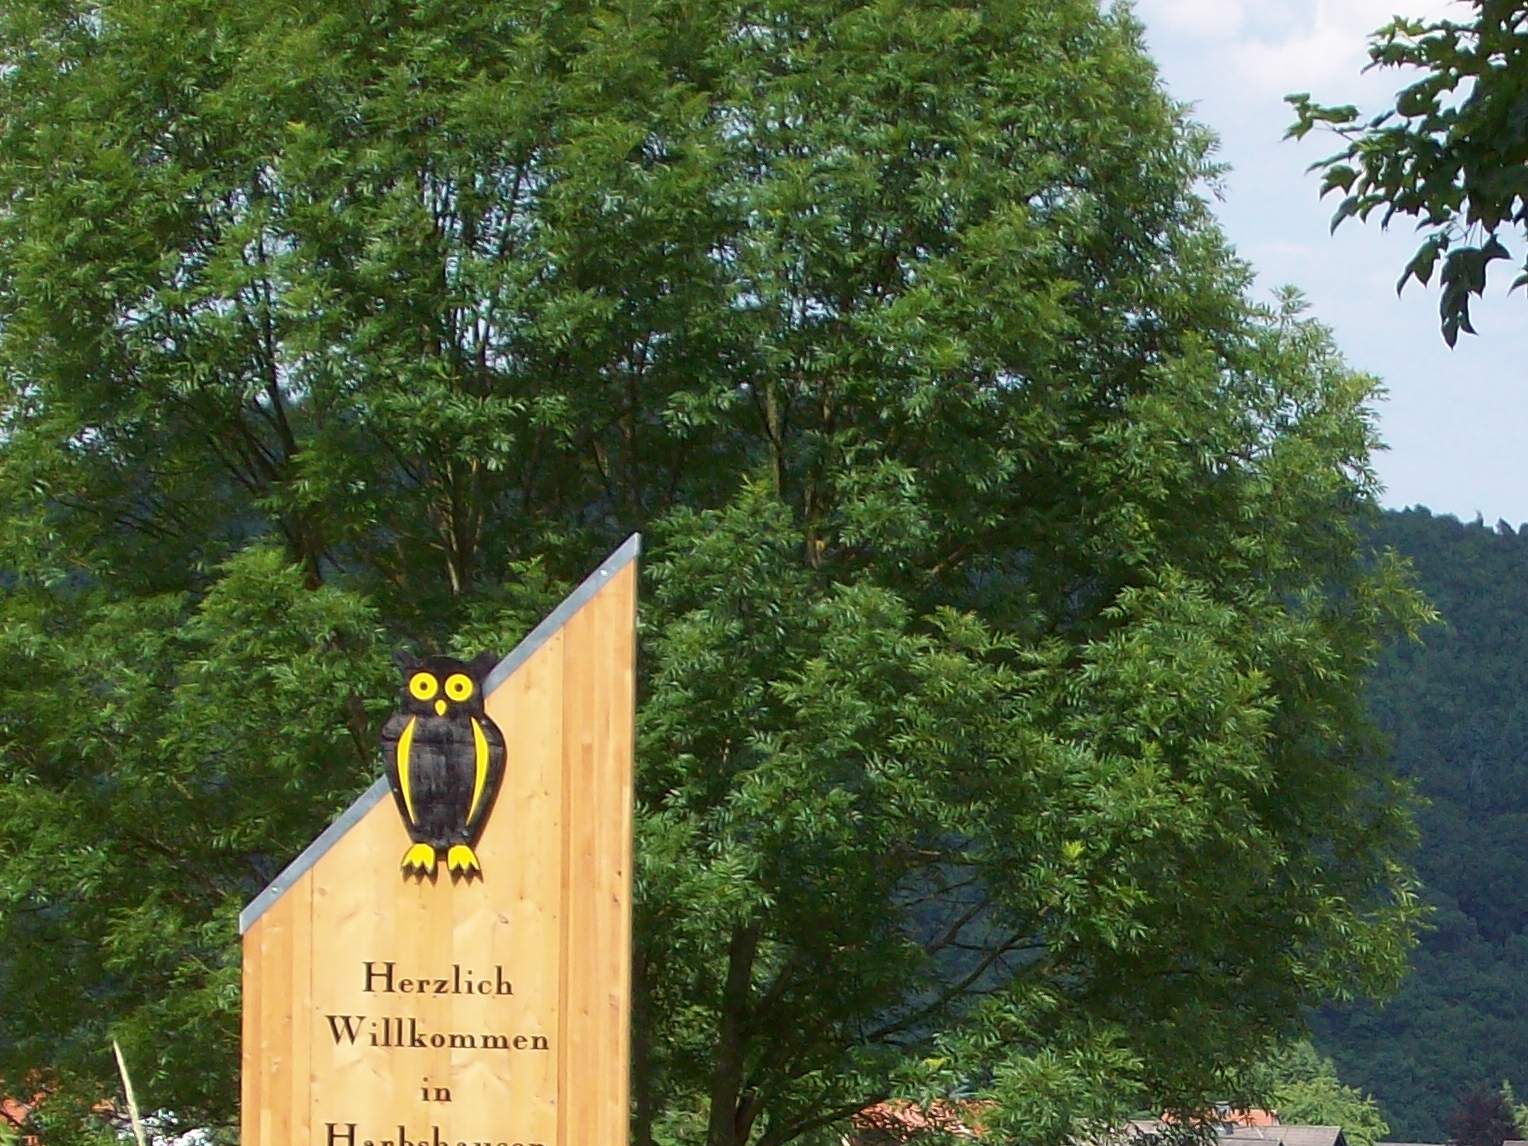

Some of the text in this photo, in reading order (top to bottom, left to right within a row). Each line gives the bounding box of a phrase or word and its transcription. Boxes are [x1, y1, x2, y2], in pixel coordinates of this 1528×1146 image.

[362, 961, 514, 996] Herzlich
[326, 1015, 549, 1051] Willkommen
[421, 1077, 452, 1102] in
